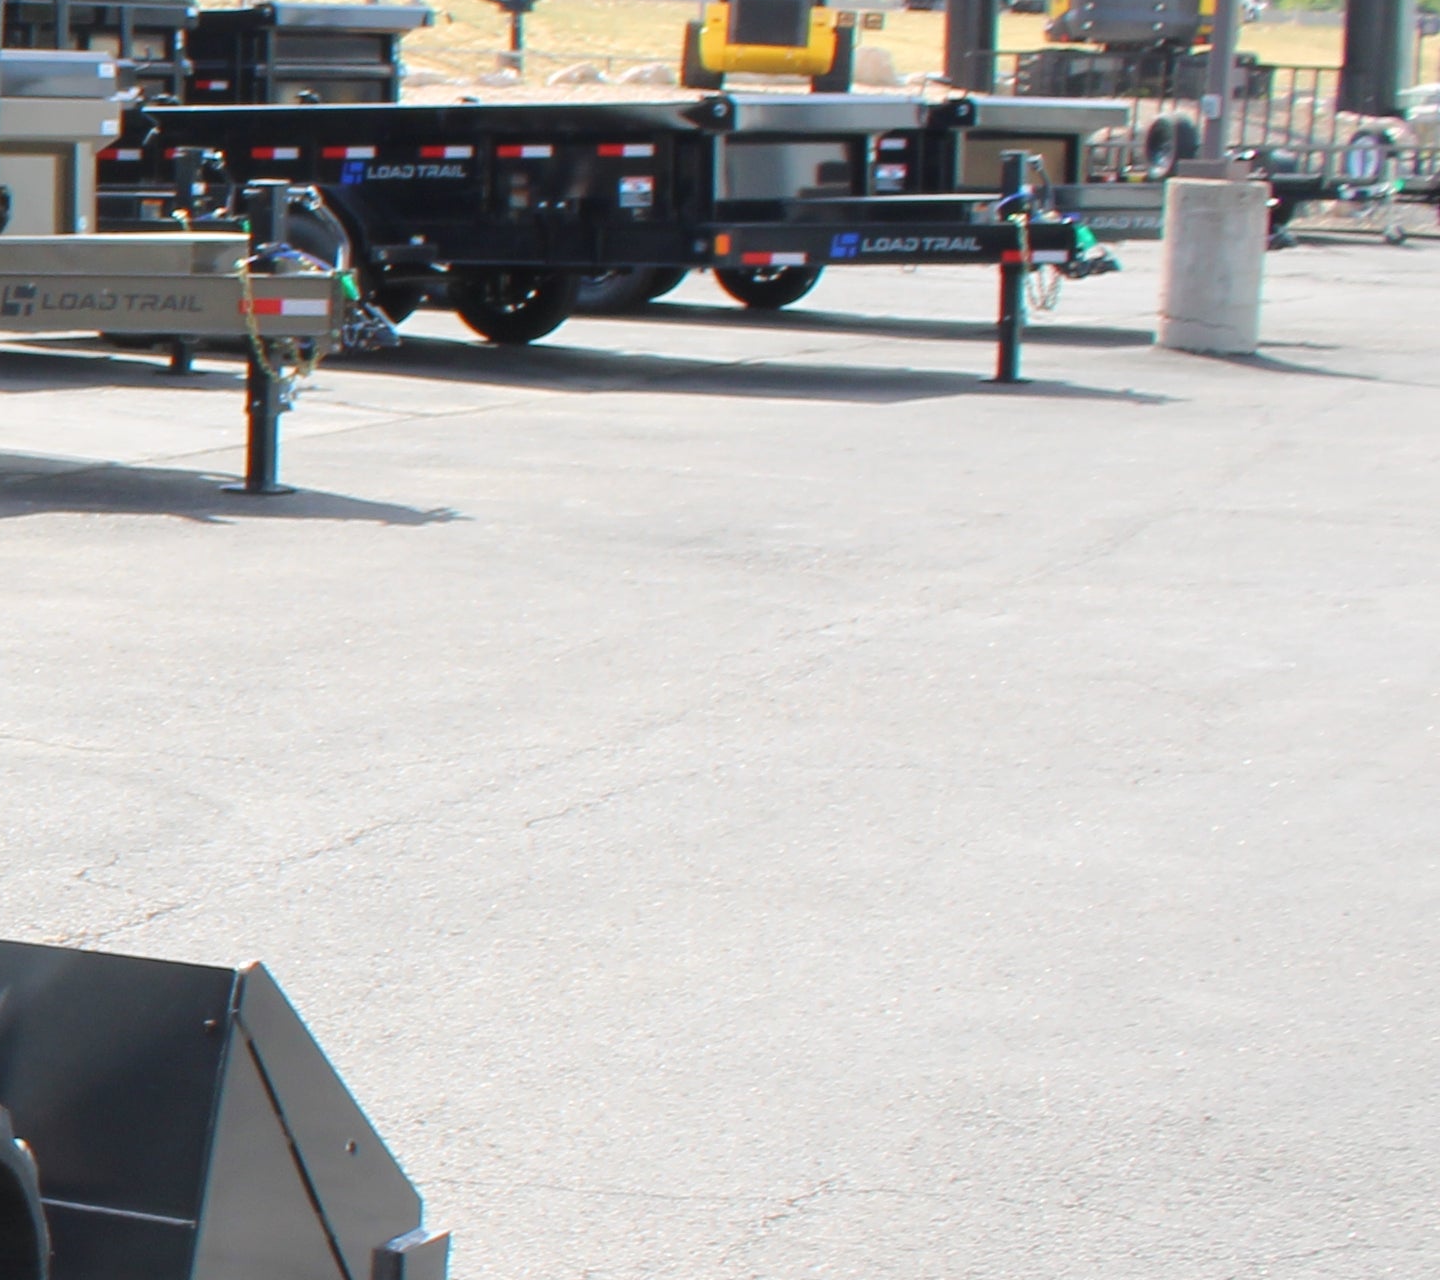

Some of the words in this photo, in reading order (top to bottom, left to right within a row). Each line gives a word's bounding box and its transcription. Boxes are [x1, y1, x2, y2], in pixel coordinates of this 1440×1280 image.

[366, 165, 414, 179] LOAD
[416, 164, 467, 178] TRAIL
[861, 237, 919, 253] LOAD
[921, 236, 983, 251] TRAIL
[40, 293, 117, 310] LOAD
[122, 294, 204, 312] TRAIL
